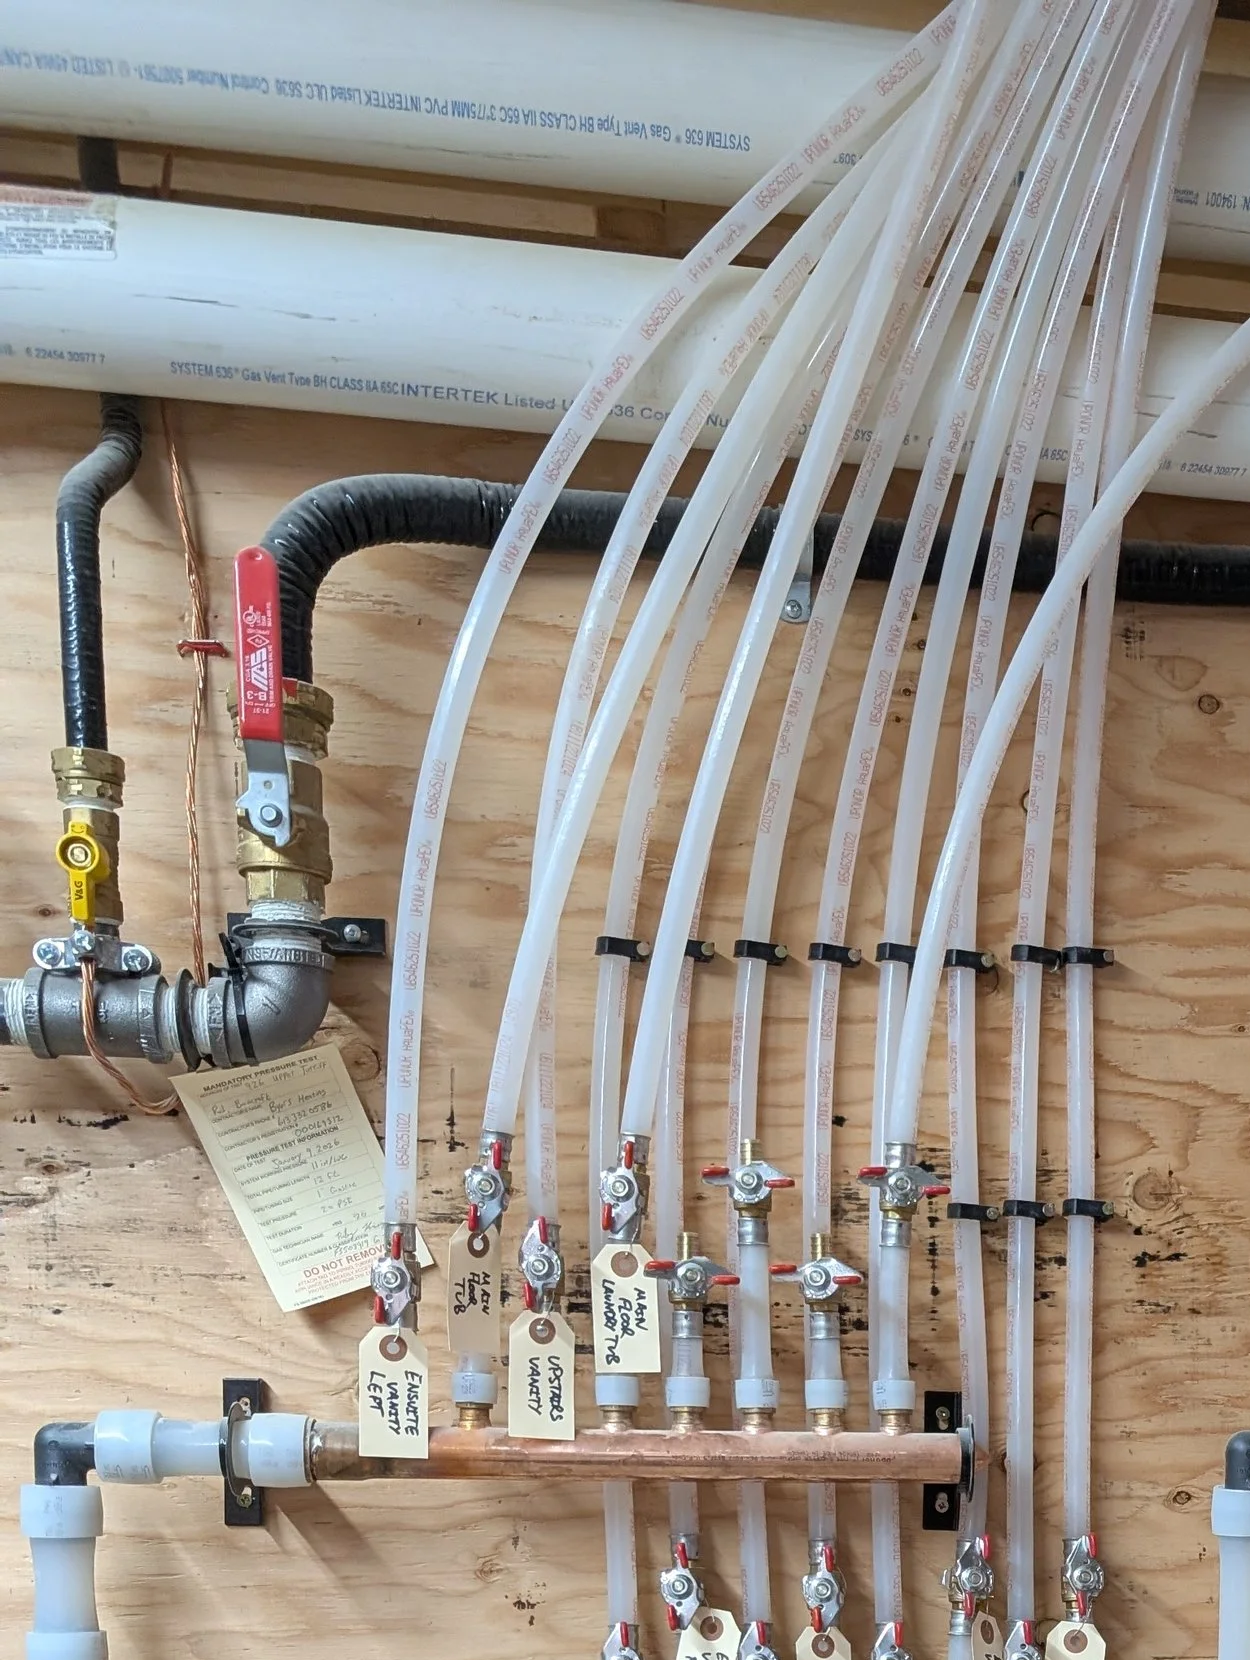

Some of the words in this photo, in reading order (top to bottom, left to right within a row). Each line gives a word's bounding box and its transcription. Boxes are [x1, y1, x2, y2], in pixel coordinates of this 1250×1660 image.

[71, 56, 114, 76] LISTED
[187, 69, 228, 90] Number
[230, 74, 270, 95] Control
[275, 79, 303, 98] S636
[306, 83, 327, 99] ULC
[330, 85, 362, 104] Listed
[365, 90, 421, 112] INTERTEK
[424, 97, 449, 118] PVC
[499, 106, 521, 125] 65C
[521, 108, 537, 126] IIA
[539, 110, 577, 131] CLASS
[579, 115, 595, 133] BH
[597, 115, 622, 136] Type
[623, 120, 648, 139] Vent
[650, 123, 672, 142] Gas
[685, 127, 704, 146] 636
[705, 131, 751, 152] SYSTEM
[170, 361, 214, 380] SYSTEM
[241, 368, 262, 383] Gas
[263, 370, 287, 386] Vent
[288, 373, 311, 389] Type
[313, 375, 328, 390] BH
[329, 376, 364, 392] CLASS
[380, 381, 399, 395] 65C
[400, 383, 499, 406] INTERTEK
[503, 393, 556, 412] Listed
[74, 880, 84, 901] V&G
[202, 1073, 252, 1092] MANDATORY
[254, 1060, 296, 1077] PRESSURE
[298, 1054, 318, 1064] TEST
[245, 1144, 280, 1160] PRESSURE
[280, 1139, 296, 1149] TEST
[296, 1125, 339, 1143] INFORMATION
[303, 1266, 320, 1278] DO
[321, 1258, 345, 1272] NOT
[345, 1244, 388, 1264] REMOV
[453, 1277, 467, 1316] TUB
[480, 1271, 491, 1316] MAIN
[601, 1279, 618, 1332] LAUNDRY
[633, 1287, 649, 1331] MAIN
[617, 1297, 635, 1339] FLOOR
[603, 1334, 621, 1366] TUB
[527, 1356, 543, 1416] VANITY
[547, 1355, 564, 1423] UPSTAIRS
[386, 1382, 401, 1436] VANITY
[404, 1370, 423, 1437] ENSUITE
